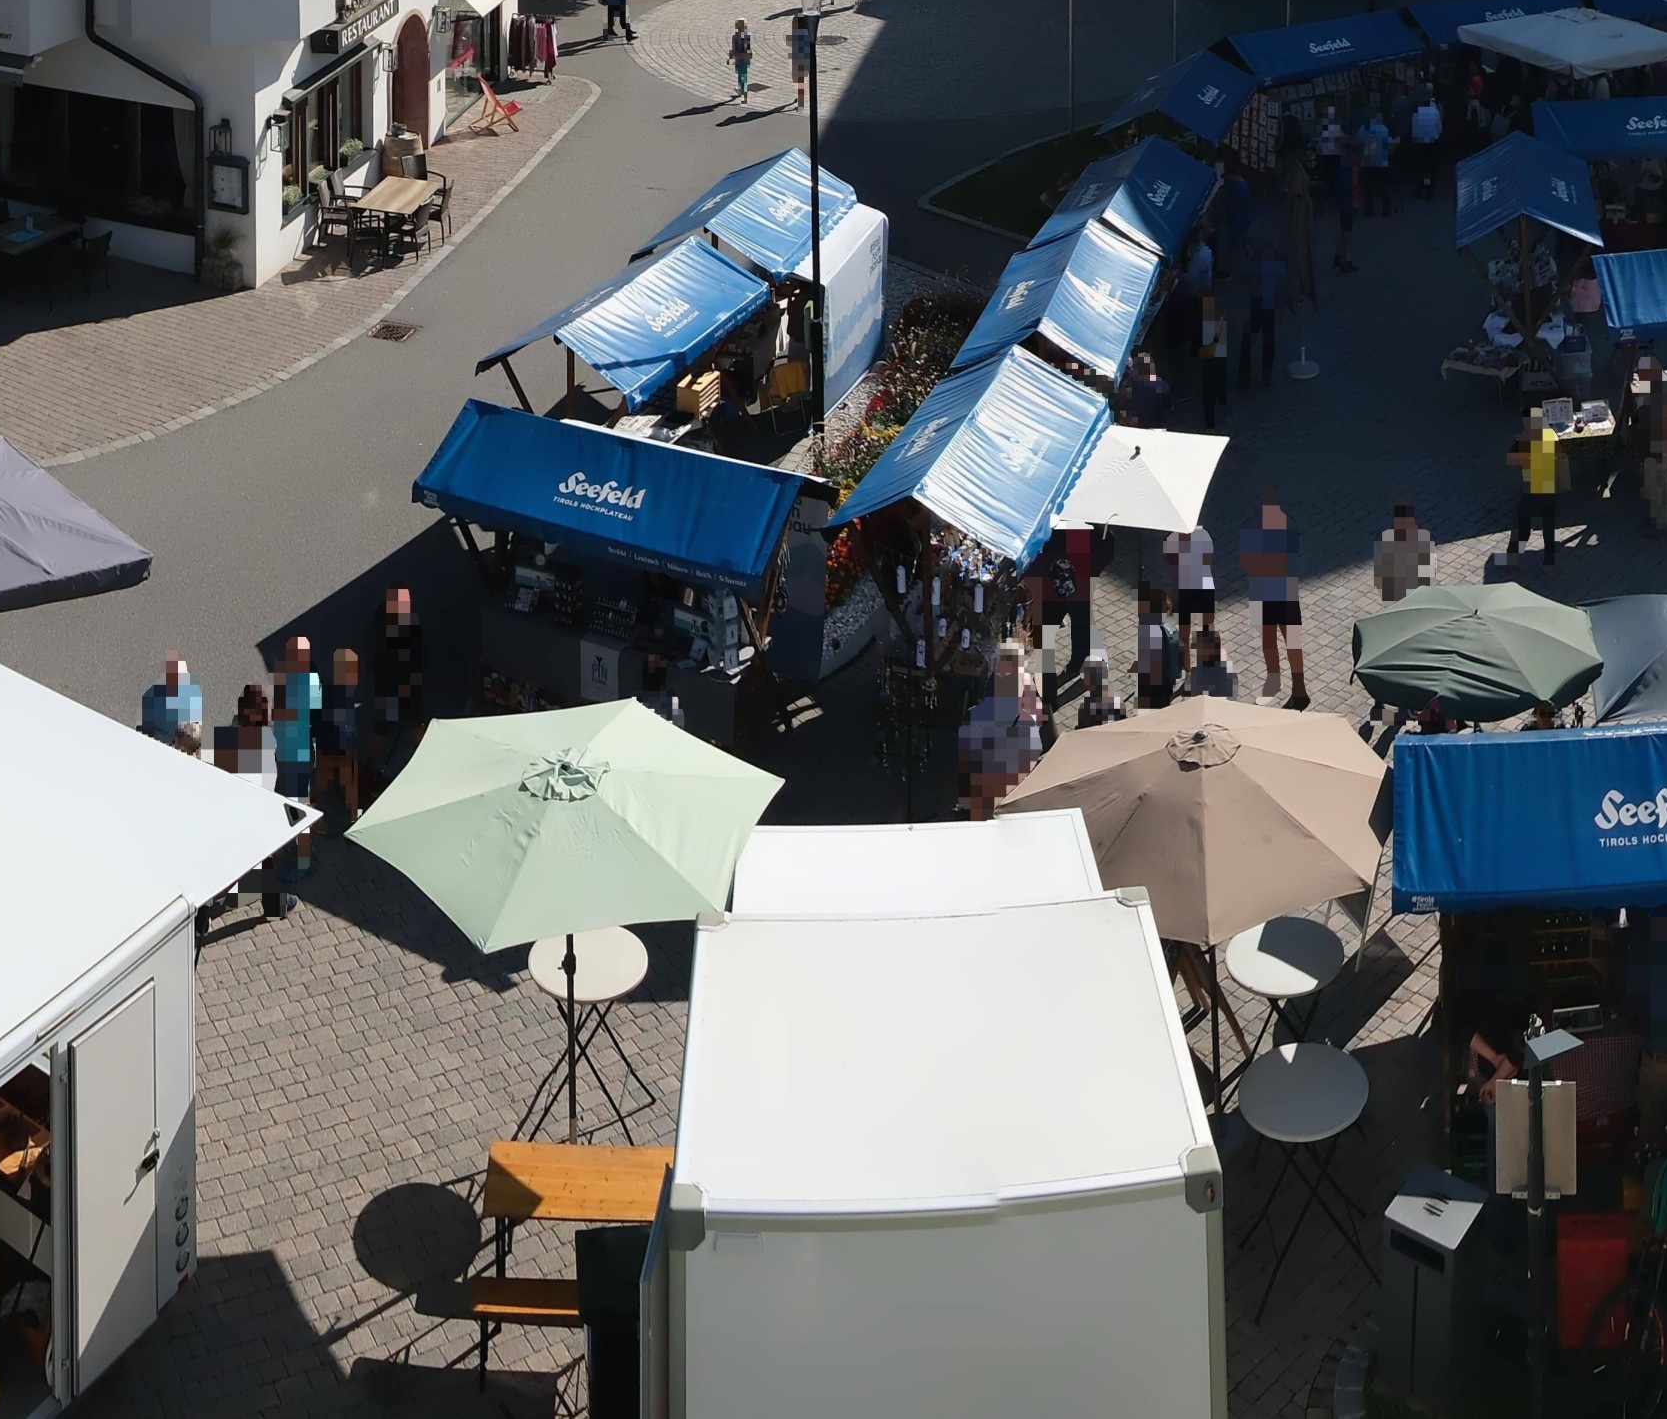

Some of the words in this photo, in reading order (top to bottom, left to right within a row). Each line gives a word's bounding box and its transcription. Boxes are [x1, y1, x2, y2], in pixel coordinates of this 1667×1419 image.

[1309, 37, 1351, 53] Seefeld
[643, 296, 690, 332] Seefeld
[558, 471, 646, 509] Seefeld
[553, 496, 579, 507] TIROLS
[580, 502, 634, 521] HOCHPLATEAU
[1599, 836, 1638, 848] TIROLS
